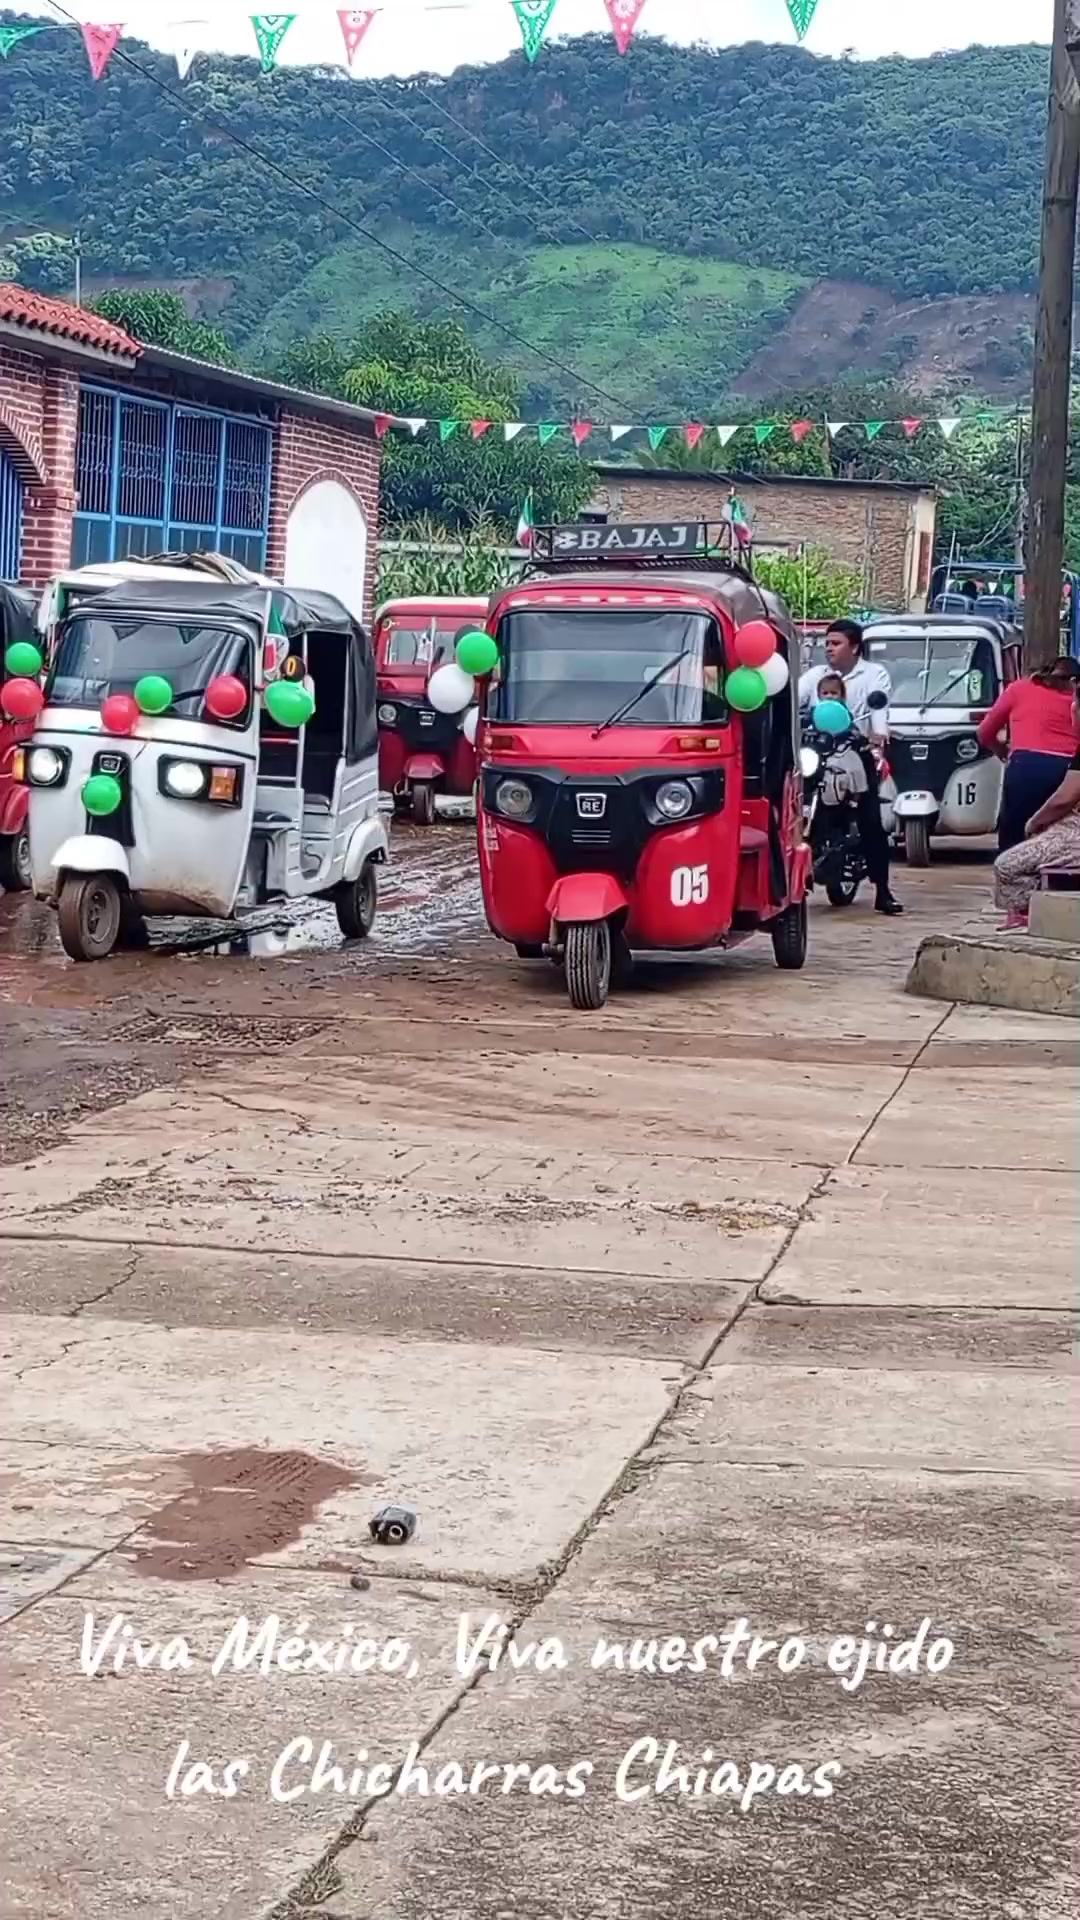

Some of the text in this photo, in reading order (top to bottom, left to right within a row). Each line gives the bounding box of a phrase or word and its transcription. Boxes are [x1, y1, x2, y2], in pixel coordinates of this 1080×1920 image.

[577, 526, 688, 550] BAJAJ
[581, 800, 601, 812] RE
[957, 782, 977, 806] 16
[670, 863, 709, 907] 05
